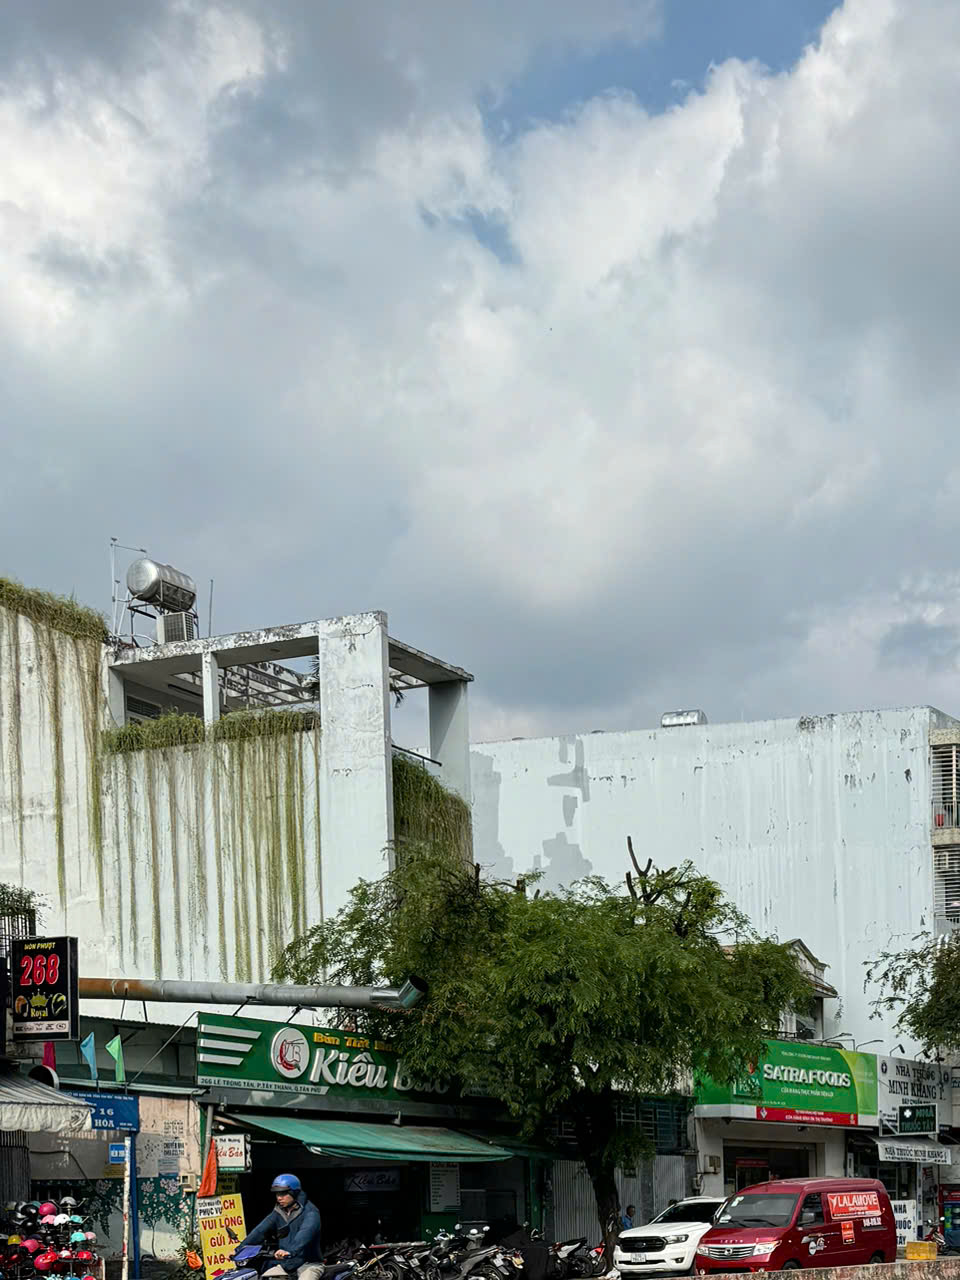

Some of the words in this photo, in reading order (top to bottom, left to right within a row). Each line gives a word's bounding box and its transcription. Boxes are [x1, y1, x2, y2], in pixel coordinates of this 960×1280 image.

[20, 953, 60, 986] 268
[30, 1008, 49, 1019] Royal
[313, 1032, 340, 1046] Bún
[763, 1064, 851, 1088] SATRAFOODS
[895, 1064, 911, 1078] NHÀ
[912, 1065, 935, 1081] THUỐC
[888, 1080, 909, 1096] MINH
[910, 1081, 937, 1099] KHANG
[99, 1108, 114, 1116] 16
[896, 1146, 913, 1157] THUỐC
[837, 1194, 879, 1207] LALAMOVE
[201, 1218, 218, 1231] VUI
[219, 1214, 243, 1228] LÒNG
[209, 1232, 226, 1248] GỬI
